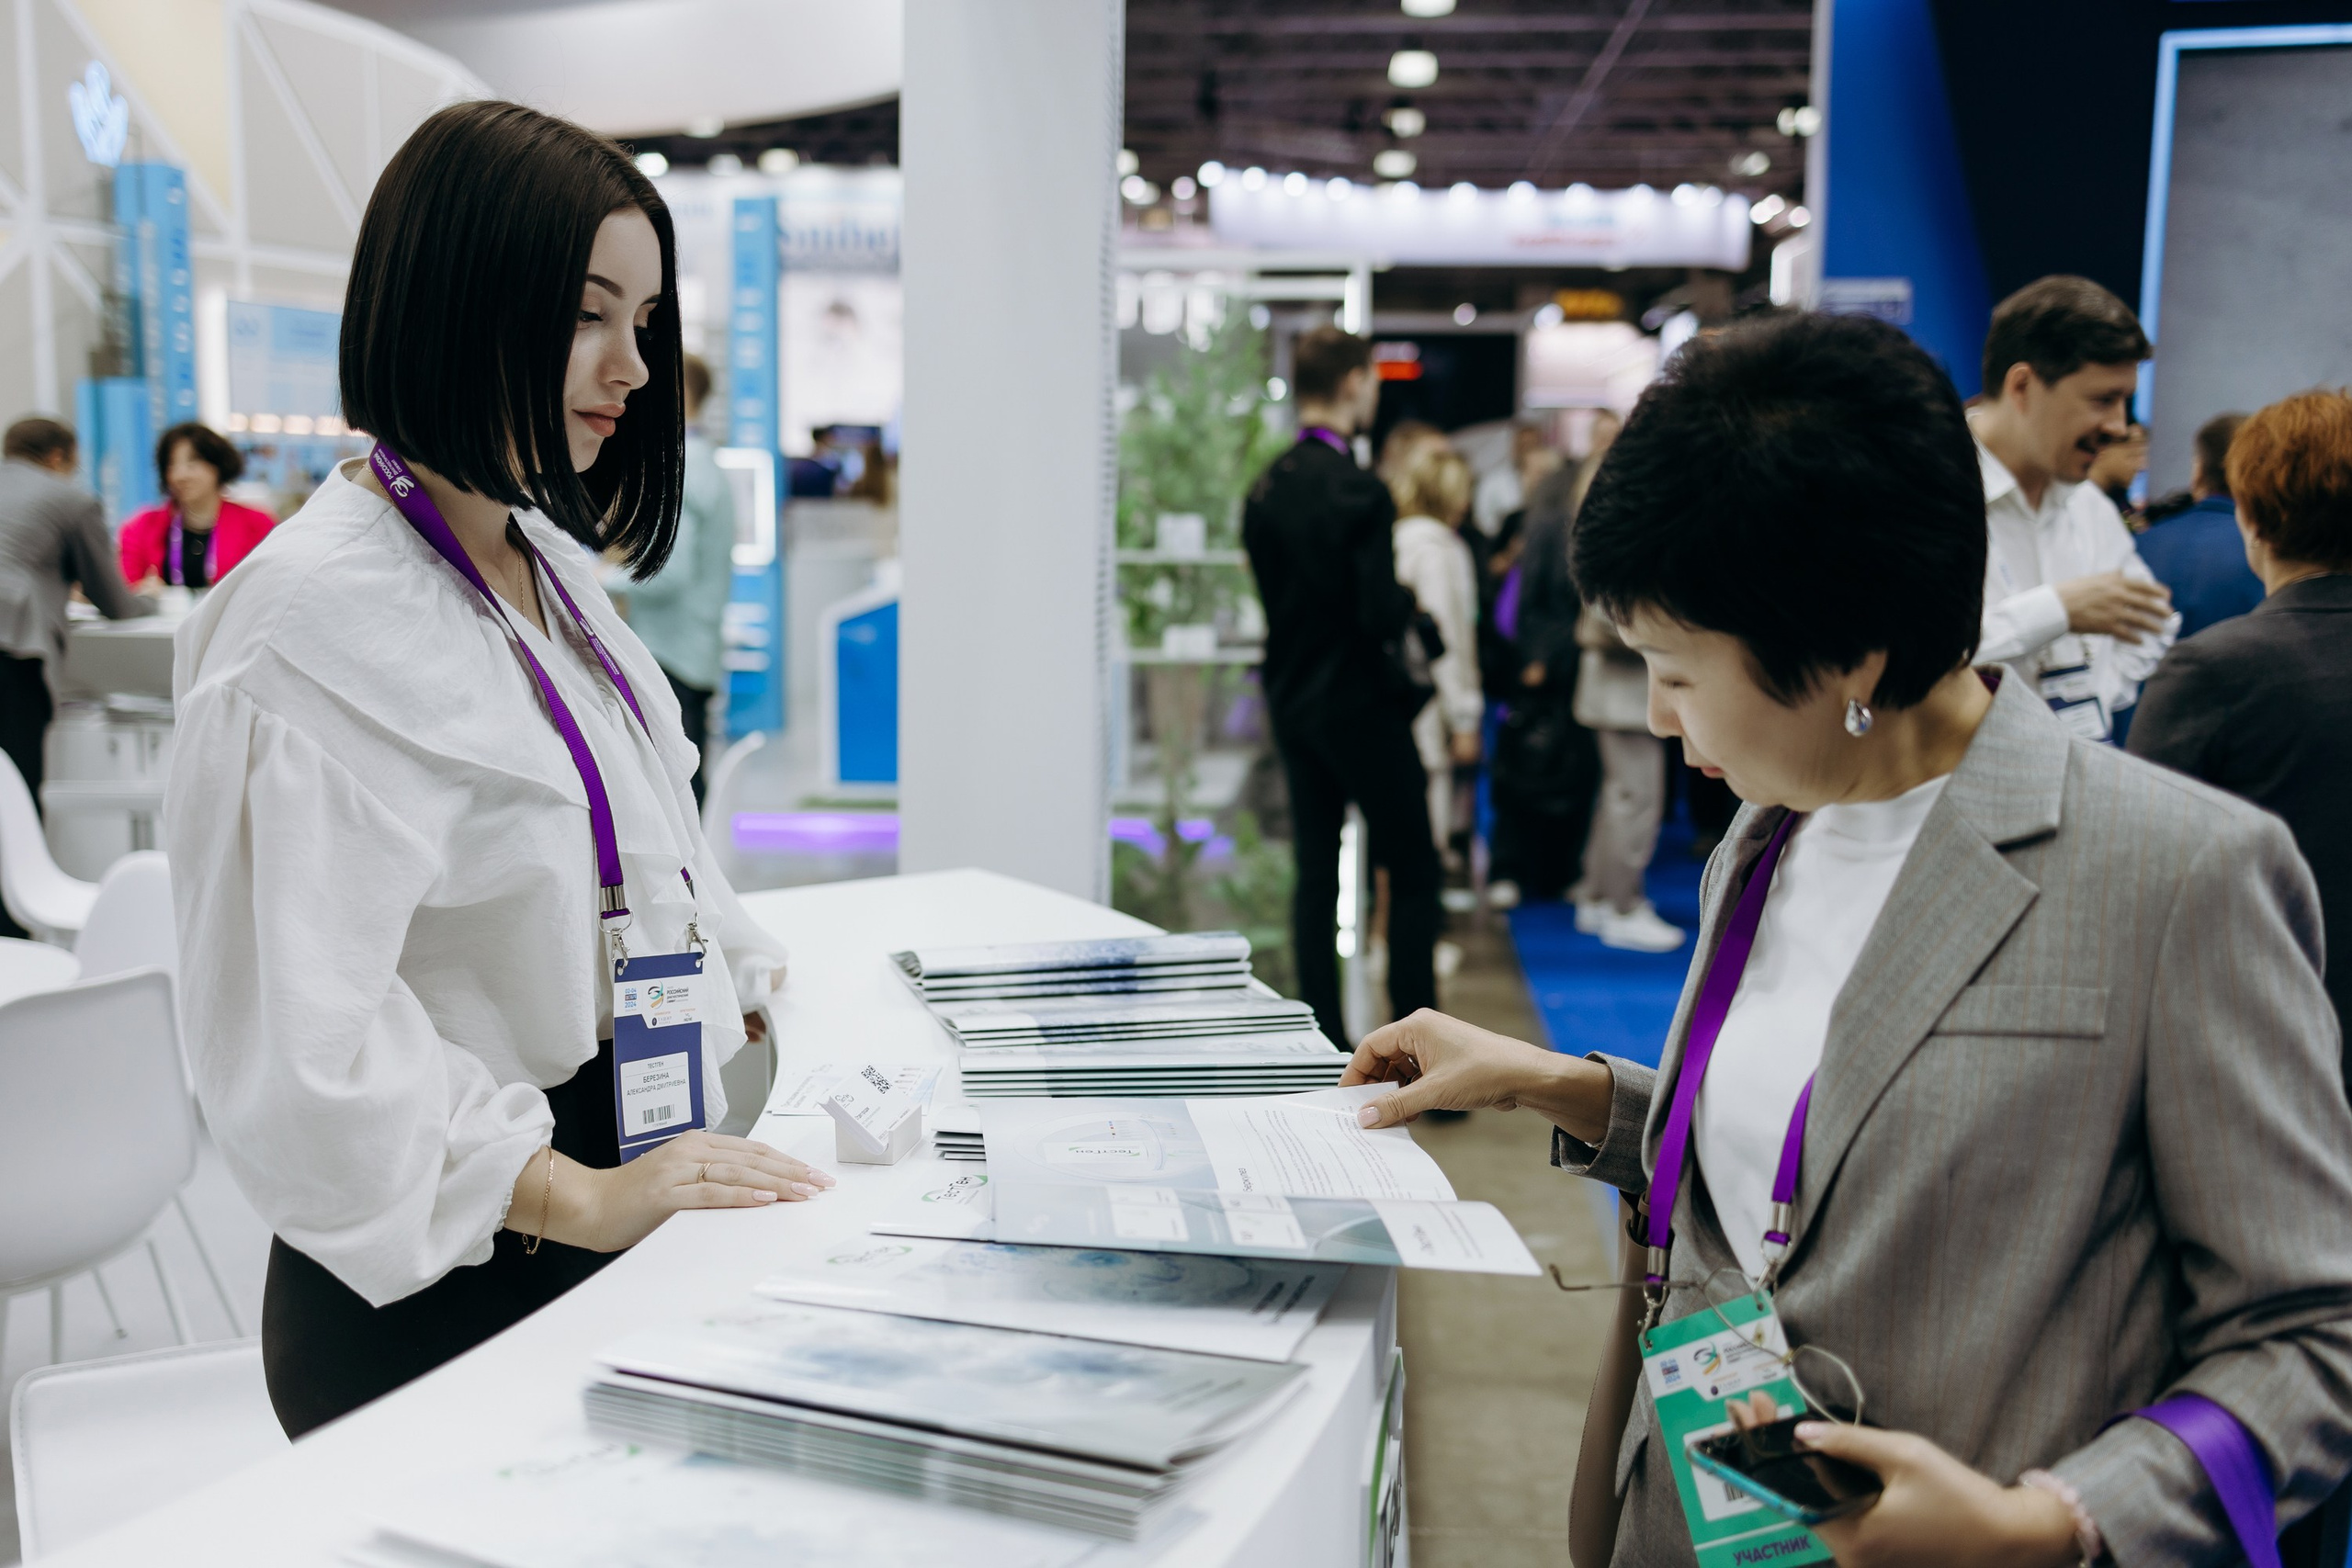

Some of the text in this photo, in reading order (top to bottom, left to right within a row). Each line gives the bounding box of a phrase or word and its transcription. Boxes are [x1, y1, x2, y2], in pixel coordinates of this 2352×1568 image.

[648, 1061, 664, 1069] ТЕСТГЕН
[643, 1072, 670, 1083] БЕРЕЗИНА
[627, 1078, 686, 1096] АЛЕКСАНДРА ДМИТРИЕВНА
[1733, 1535, 1812, 1567] УЧАСТНИК
